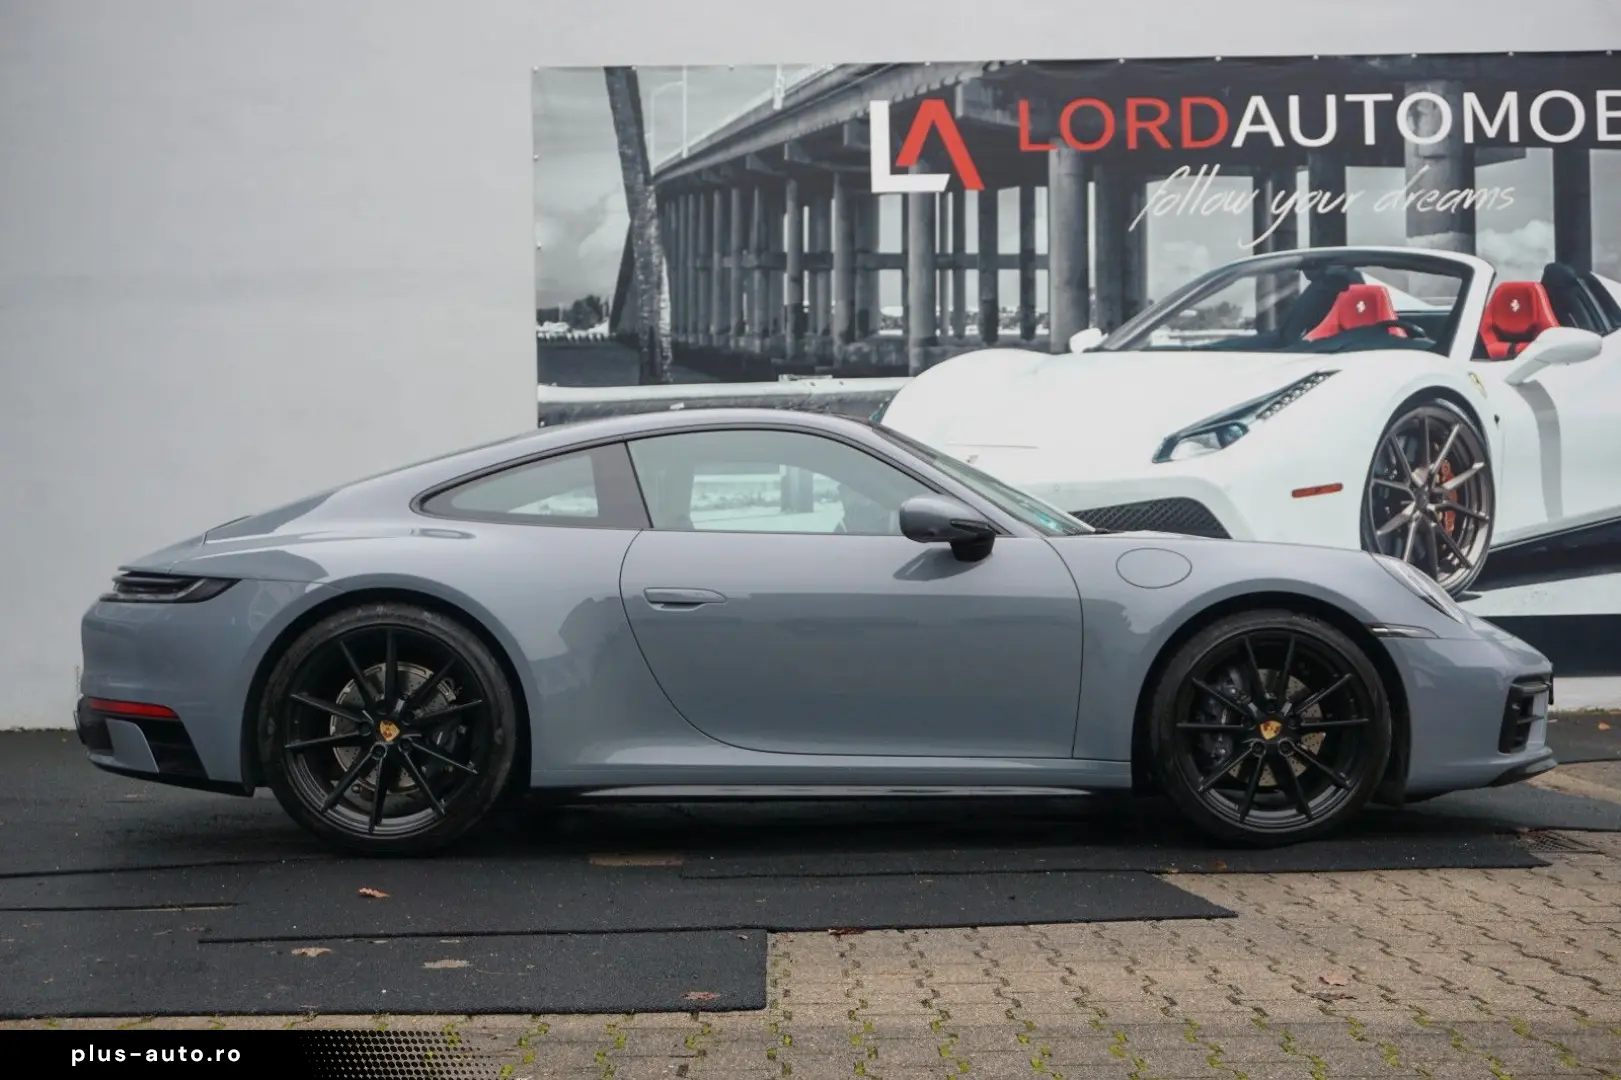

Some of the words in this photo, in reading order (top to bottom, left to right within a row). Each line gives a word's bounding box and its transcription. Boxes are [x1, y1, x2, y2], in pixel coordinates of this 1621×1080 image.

[870, 98, 985, 193] LA
[1128, 163, 1260, 232] follow
[1237, 189, 1366, 249] your
[1373, 164, 1515, 213] dreams
